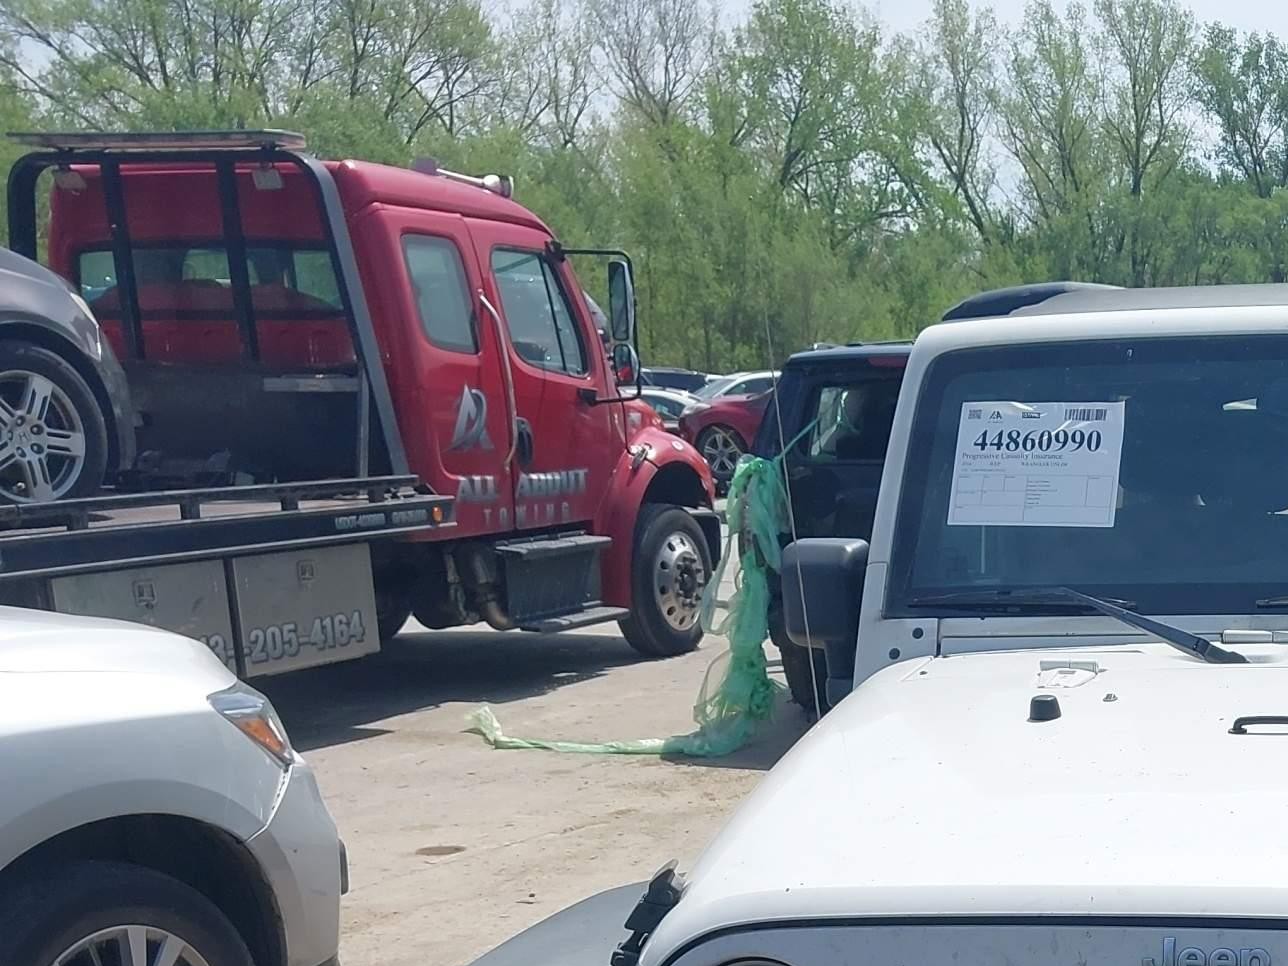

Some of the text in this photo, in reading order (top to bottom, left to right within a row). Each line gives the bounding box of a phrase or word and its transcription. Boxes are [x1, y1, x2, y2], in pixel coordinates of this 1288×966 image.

[973, 430, 1101, 452] 44860990
[456, 468, 588, 501] ALL ABOUT
[483, 502, 570, 526] TOWING
